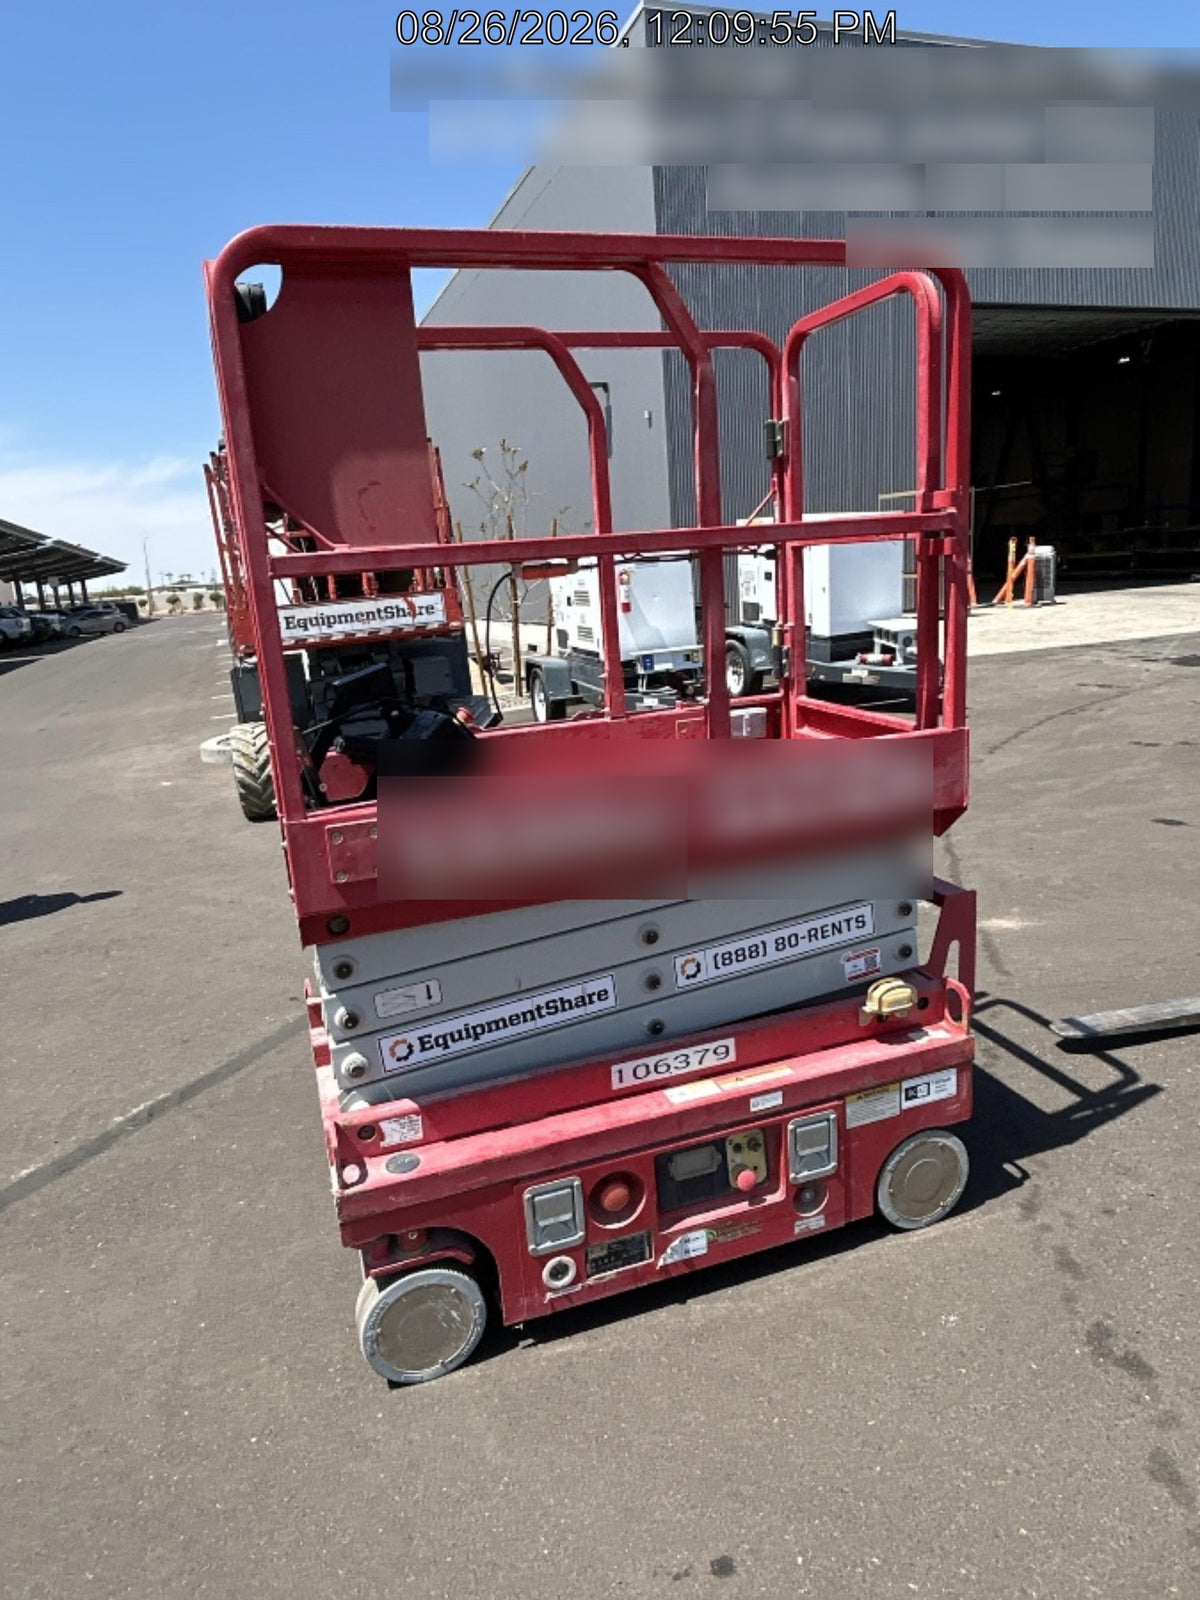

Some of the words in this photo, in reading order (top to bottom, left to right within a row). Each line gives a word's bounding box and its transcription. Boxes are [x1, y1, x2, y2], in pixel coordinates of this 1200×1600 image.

[713, 939, 768, 971] (888)
[774, 913, 867, 953] 80-RENTS
[416, 986, 610, 1054] EquipmentShare
[615, 1044, 730, 1084] 106379
